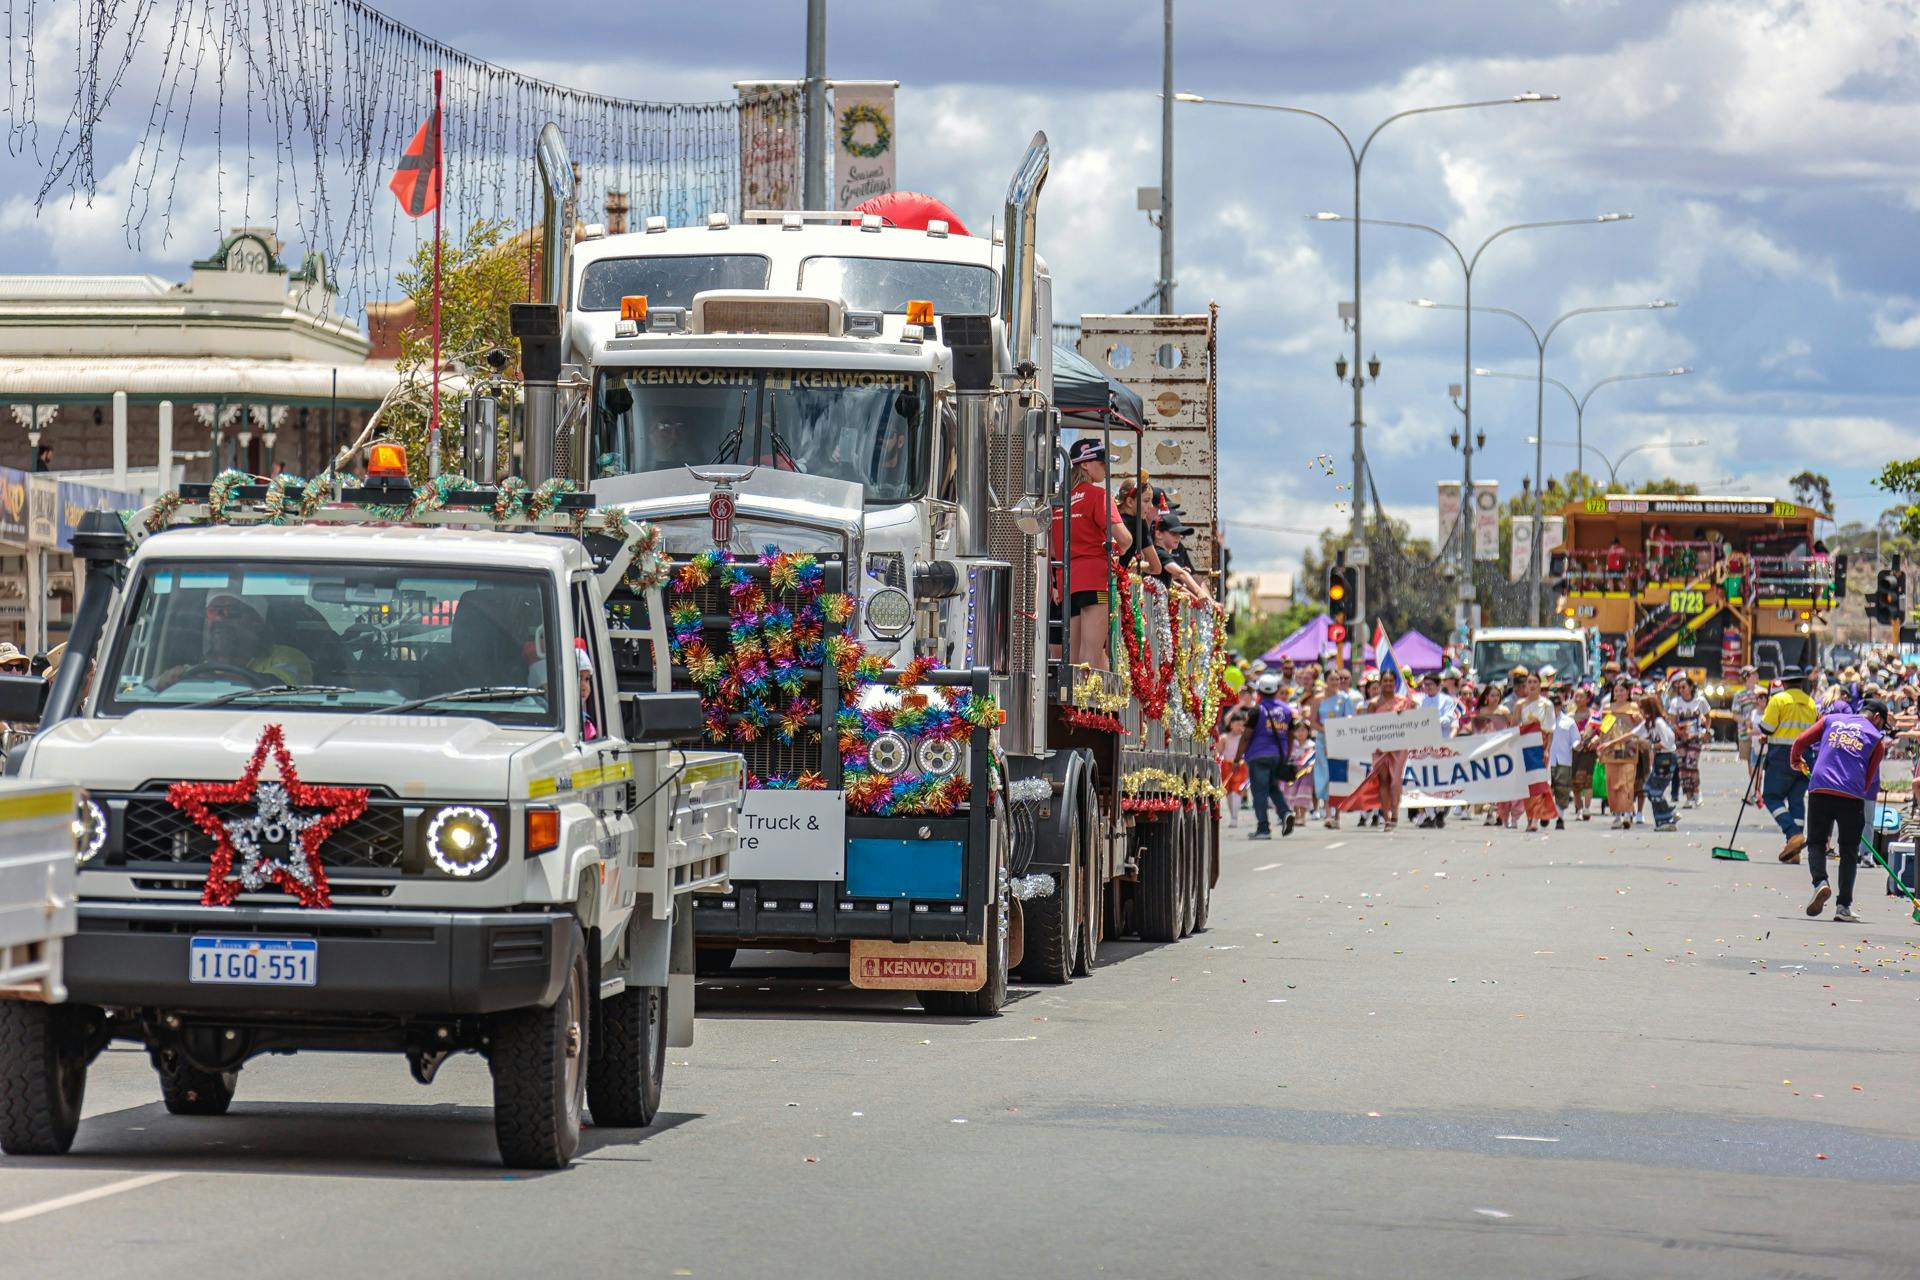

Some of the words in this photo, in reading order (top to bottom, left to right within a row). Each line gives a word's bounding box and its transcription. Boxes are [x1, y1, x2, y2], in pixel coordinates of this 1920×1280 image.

[632, 368, 753, 385] KENWORTH
[795, 370, 914, 391] KENWORTH
[1655, 502, 1702, 512] MINING
[1704, 502, 1767, 514] SERVICES
[1670, 591, 1704, 613] 6723
[1349, 726, 1367, 735] Thai
[1369, 720, 1419, 733] Community
[1361, 730, 1406, 742] Kalgoorlie
[1359, 754, 1514, 788] TAILAND
[744, 814, 801, 830] Truck
[806, 815, 820, 831] &
[739, 836, 759, 849] re
[883, 960, 973, 976] KENWORTH
